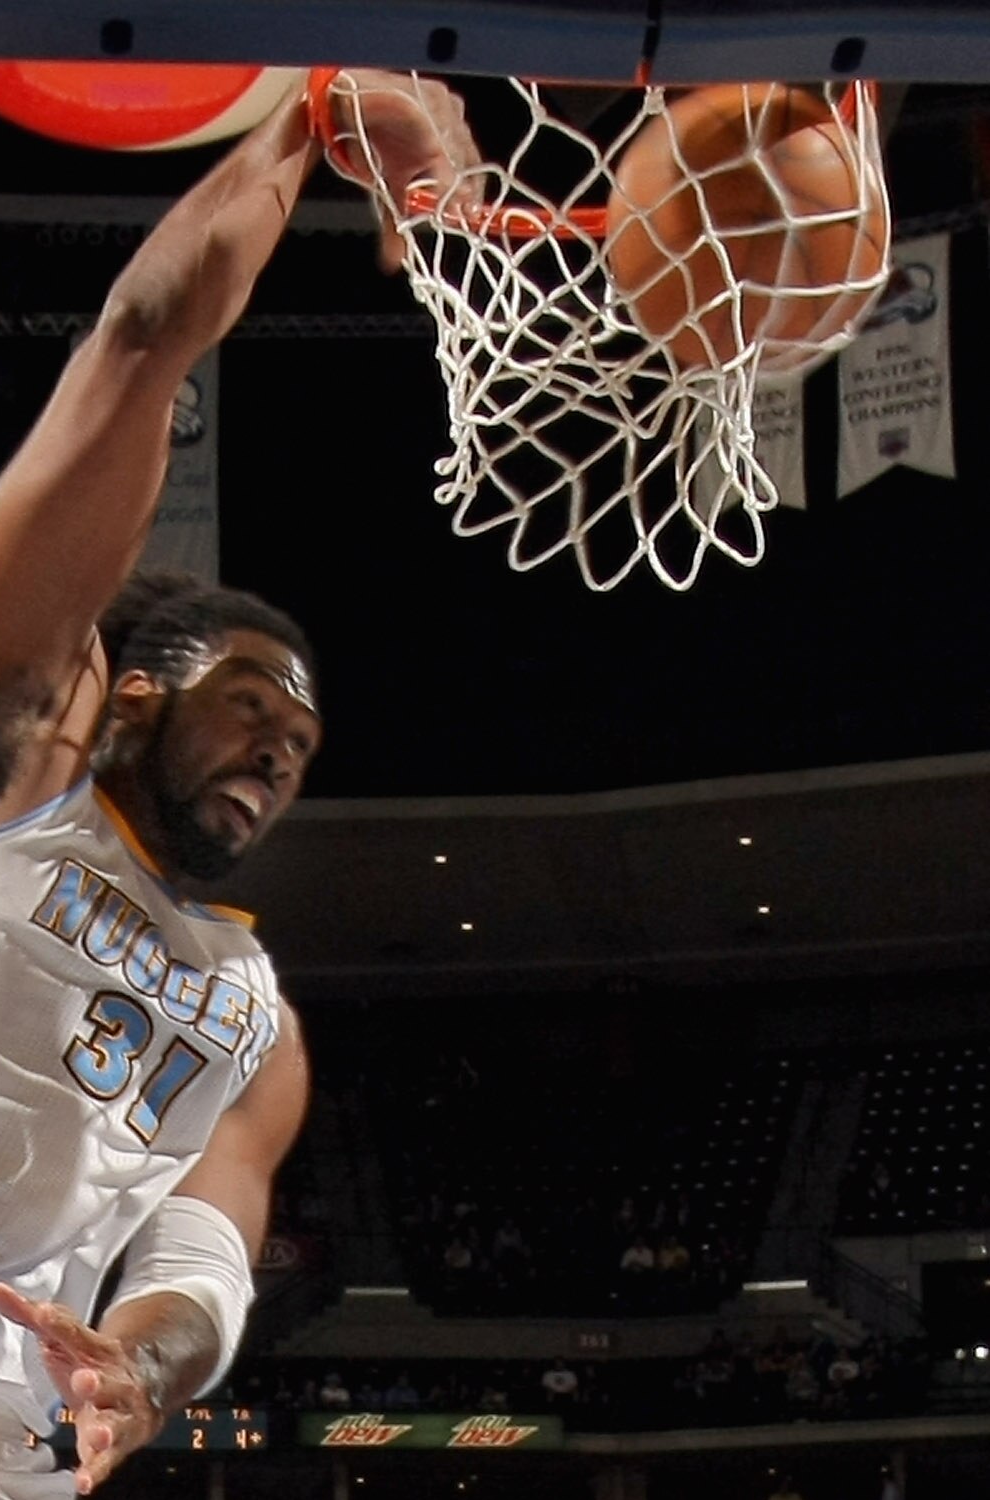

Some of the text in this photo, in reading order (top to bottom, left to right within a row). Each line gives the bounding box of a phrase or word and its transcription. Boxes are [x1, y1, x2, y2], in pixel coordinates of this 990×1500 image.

[852, 356, 935, 384] WESTERN
[62, 989, 210, 1148] 31
[192, 1428, 204, 1450] 2
